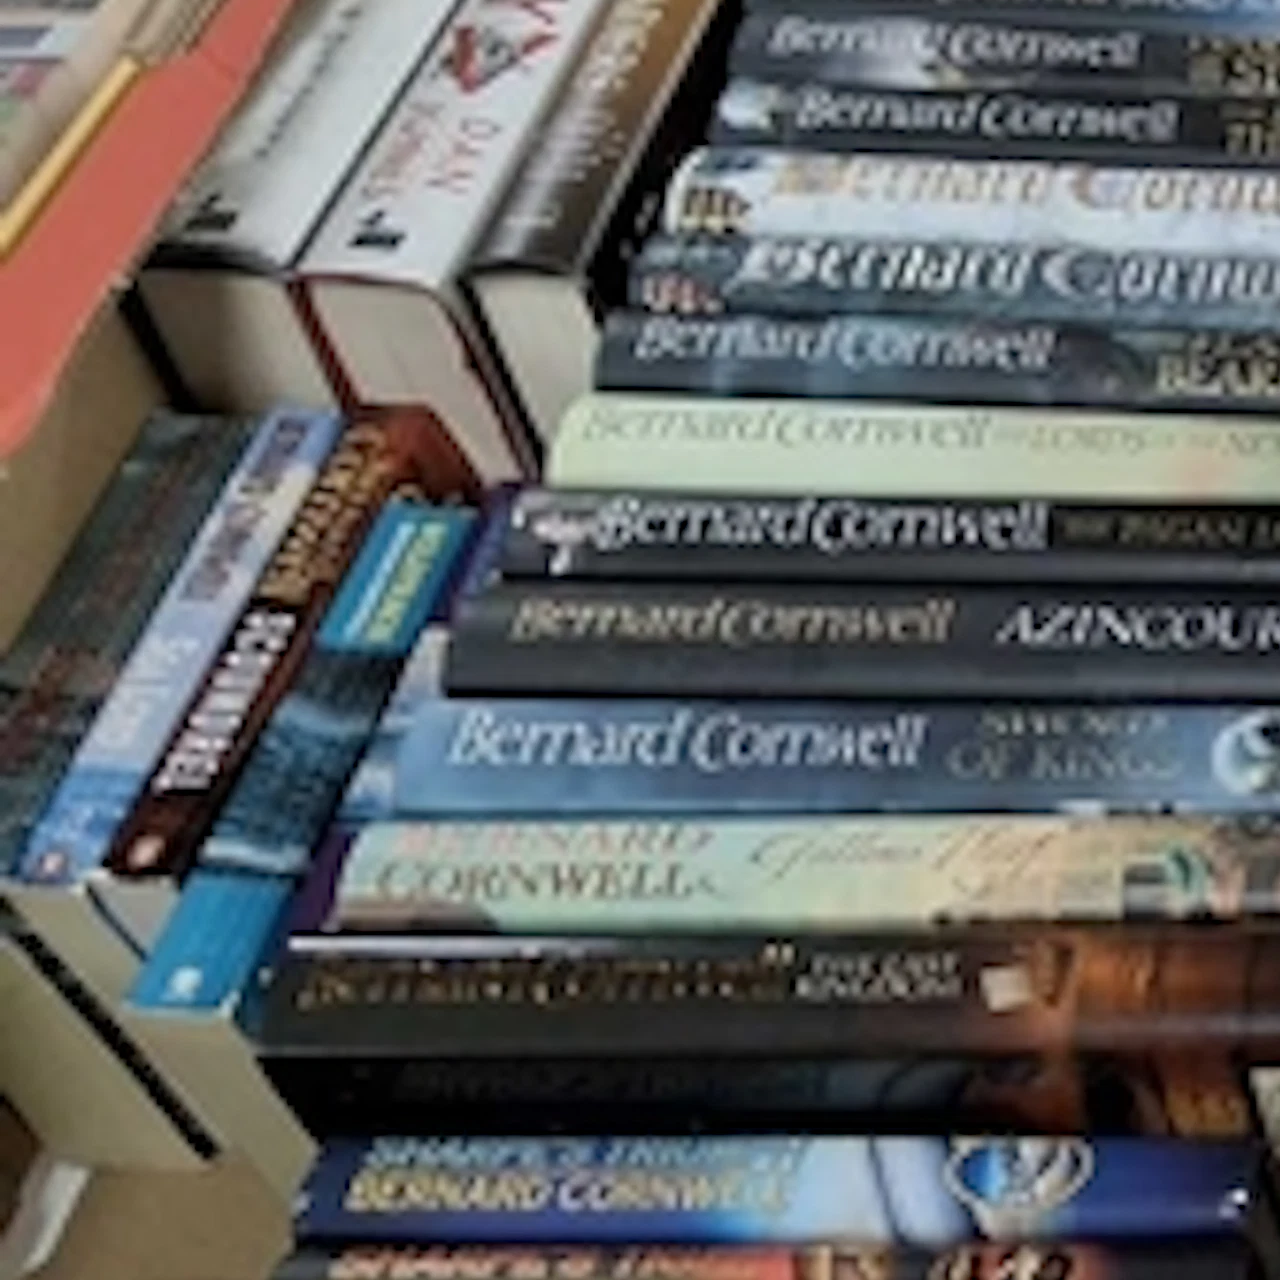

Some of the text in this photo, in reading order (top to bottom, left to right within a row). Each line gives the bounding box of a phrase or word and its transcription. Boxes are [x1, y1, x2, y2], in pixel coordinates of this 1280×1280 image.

[948, 26, 1143, 69] Cornwell
[795, 90, 1181, 143] Bernard Cornwell
[633, 317, 1057, 370] Bernard Cornwell
[602, 497, 812, 550] Bernard
[808, 501, 1052, 556] Cornwell
[509, 596, 722, 645] Bernard
[720, 599, 958, 650] Cornwell
[447, 712, 928, 771] Bernard Cornwell
[374, 856, 704, 901] CORNWELL
[344, 1166, 789, 1214] BERNARD CORNWELL
